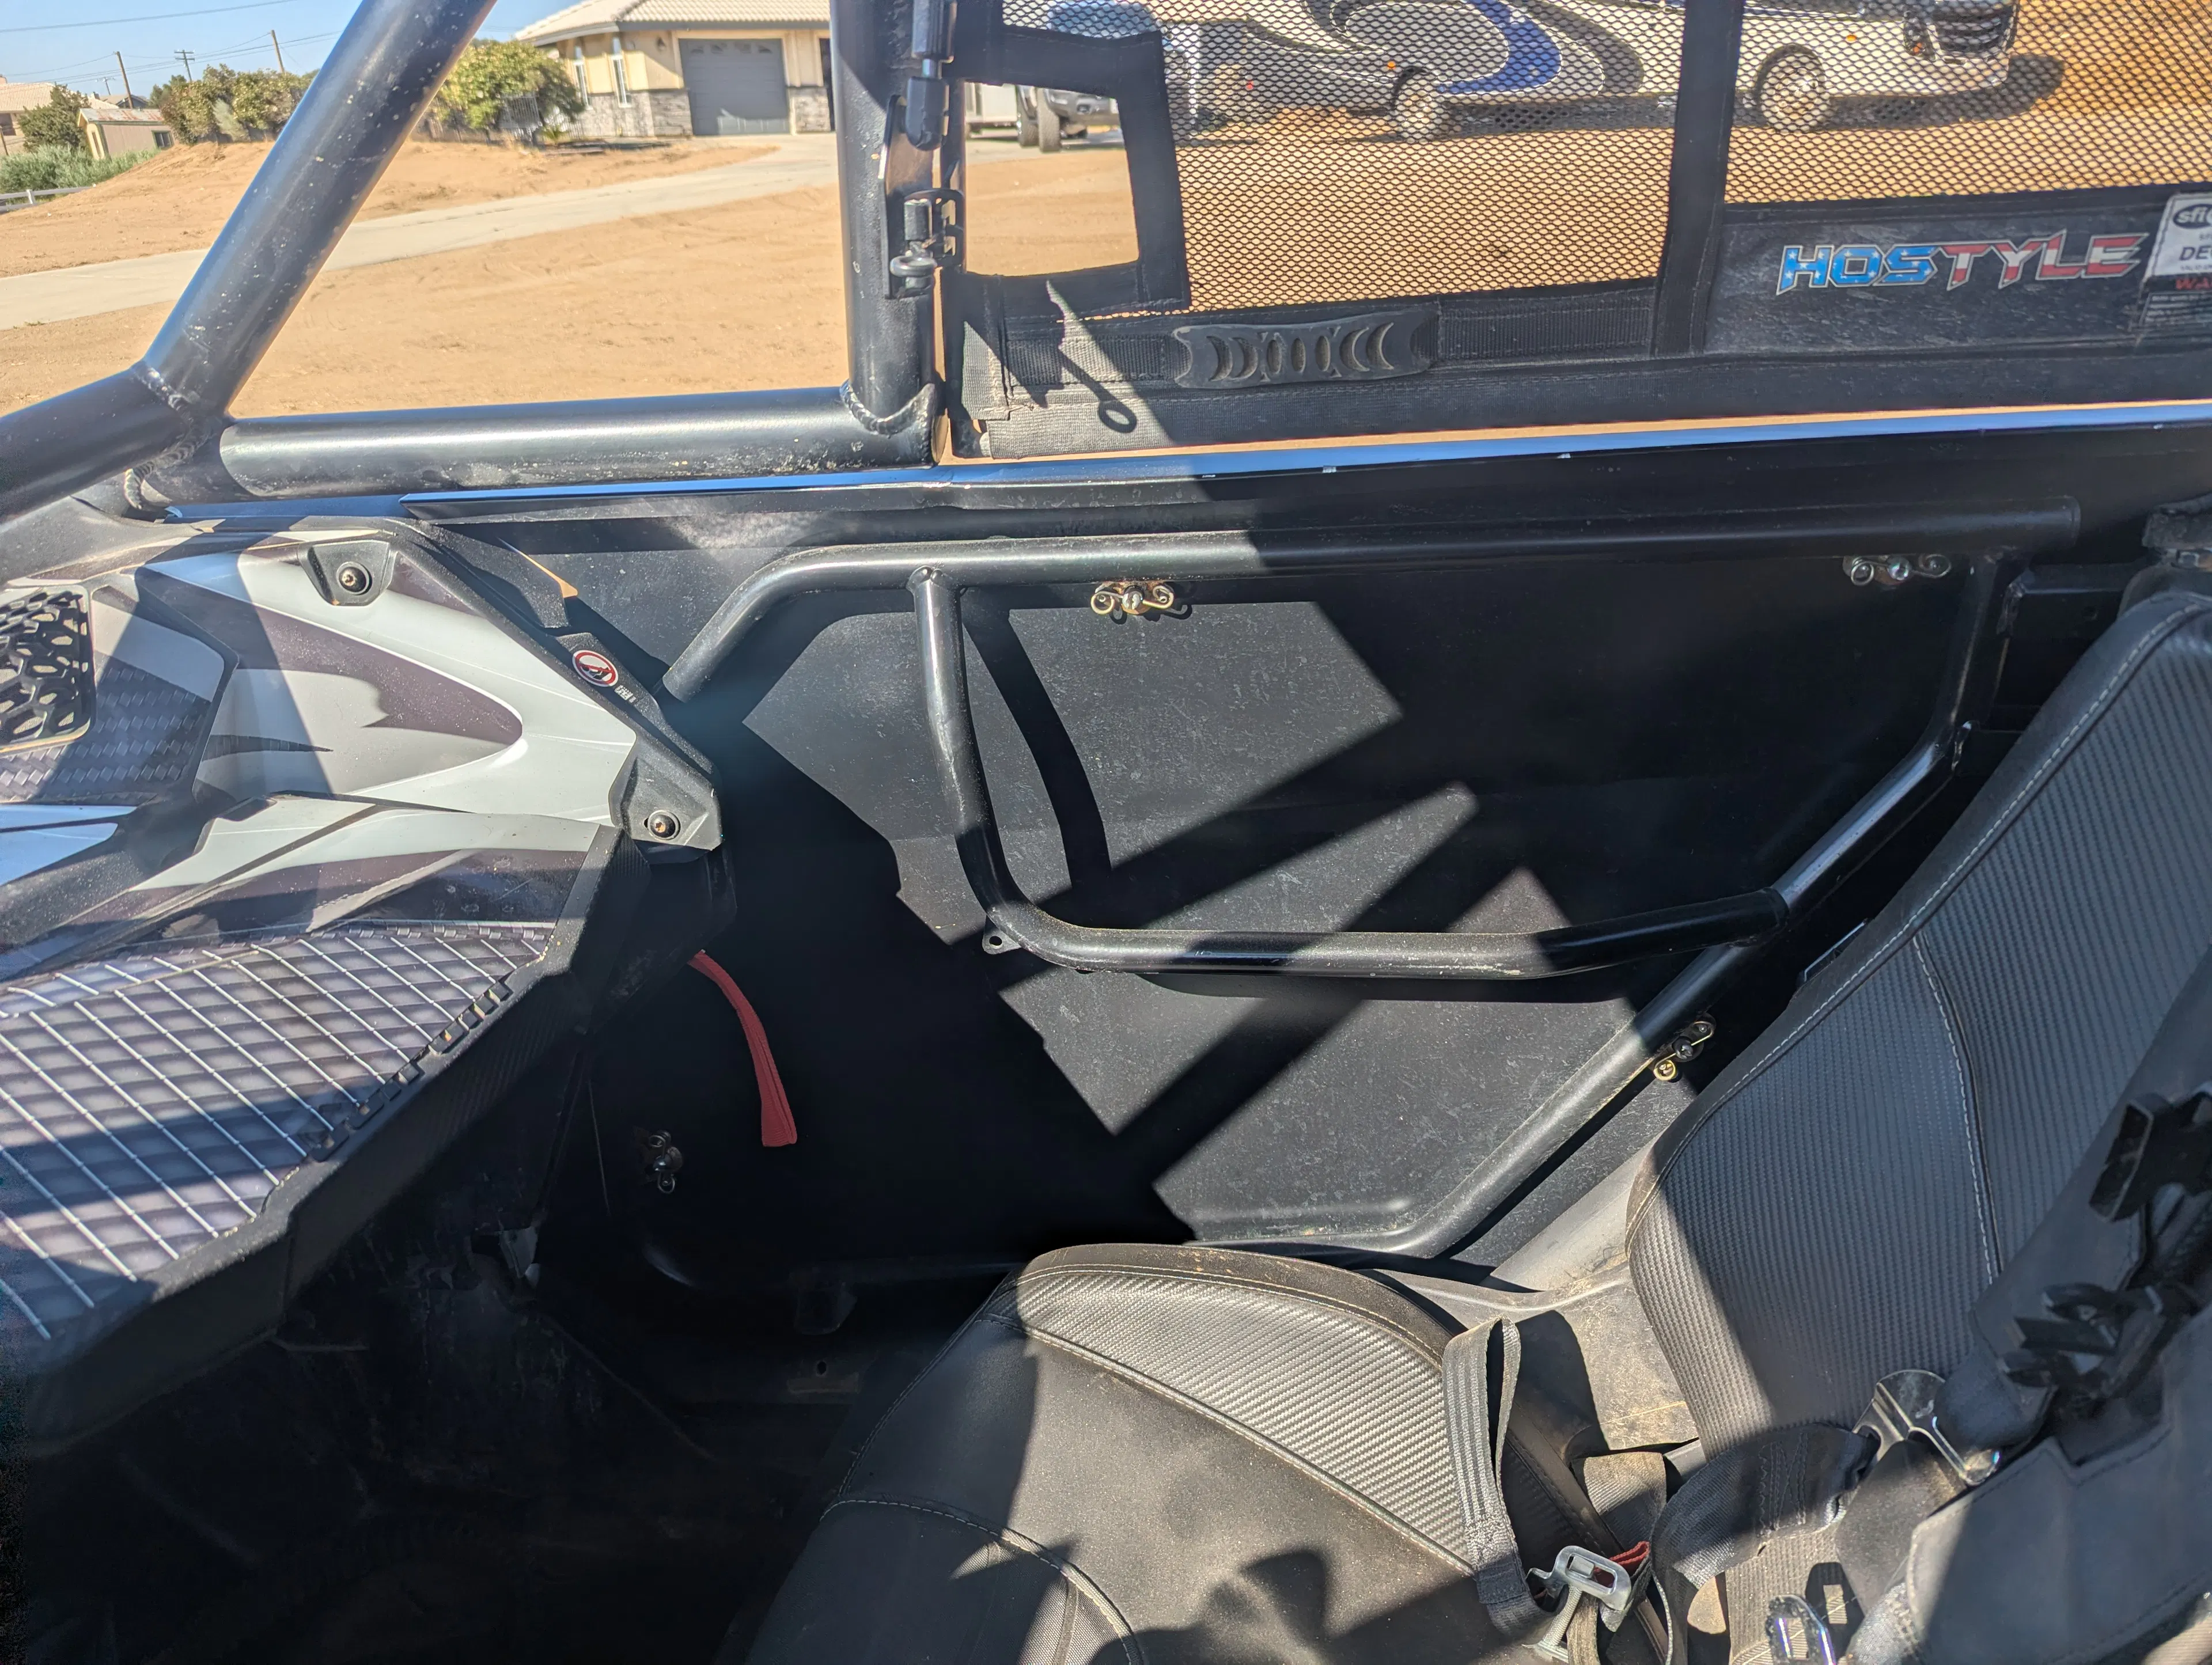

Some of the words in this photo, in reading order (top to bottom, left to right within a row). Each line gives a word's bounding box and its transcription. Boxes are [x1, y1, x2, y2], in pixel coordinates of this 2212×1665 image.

[2176, 206, 2208, 224] sfi
[1776, 229, 2149, 295] HOSTYLE
[2179, 245, 2212, 261] DE
